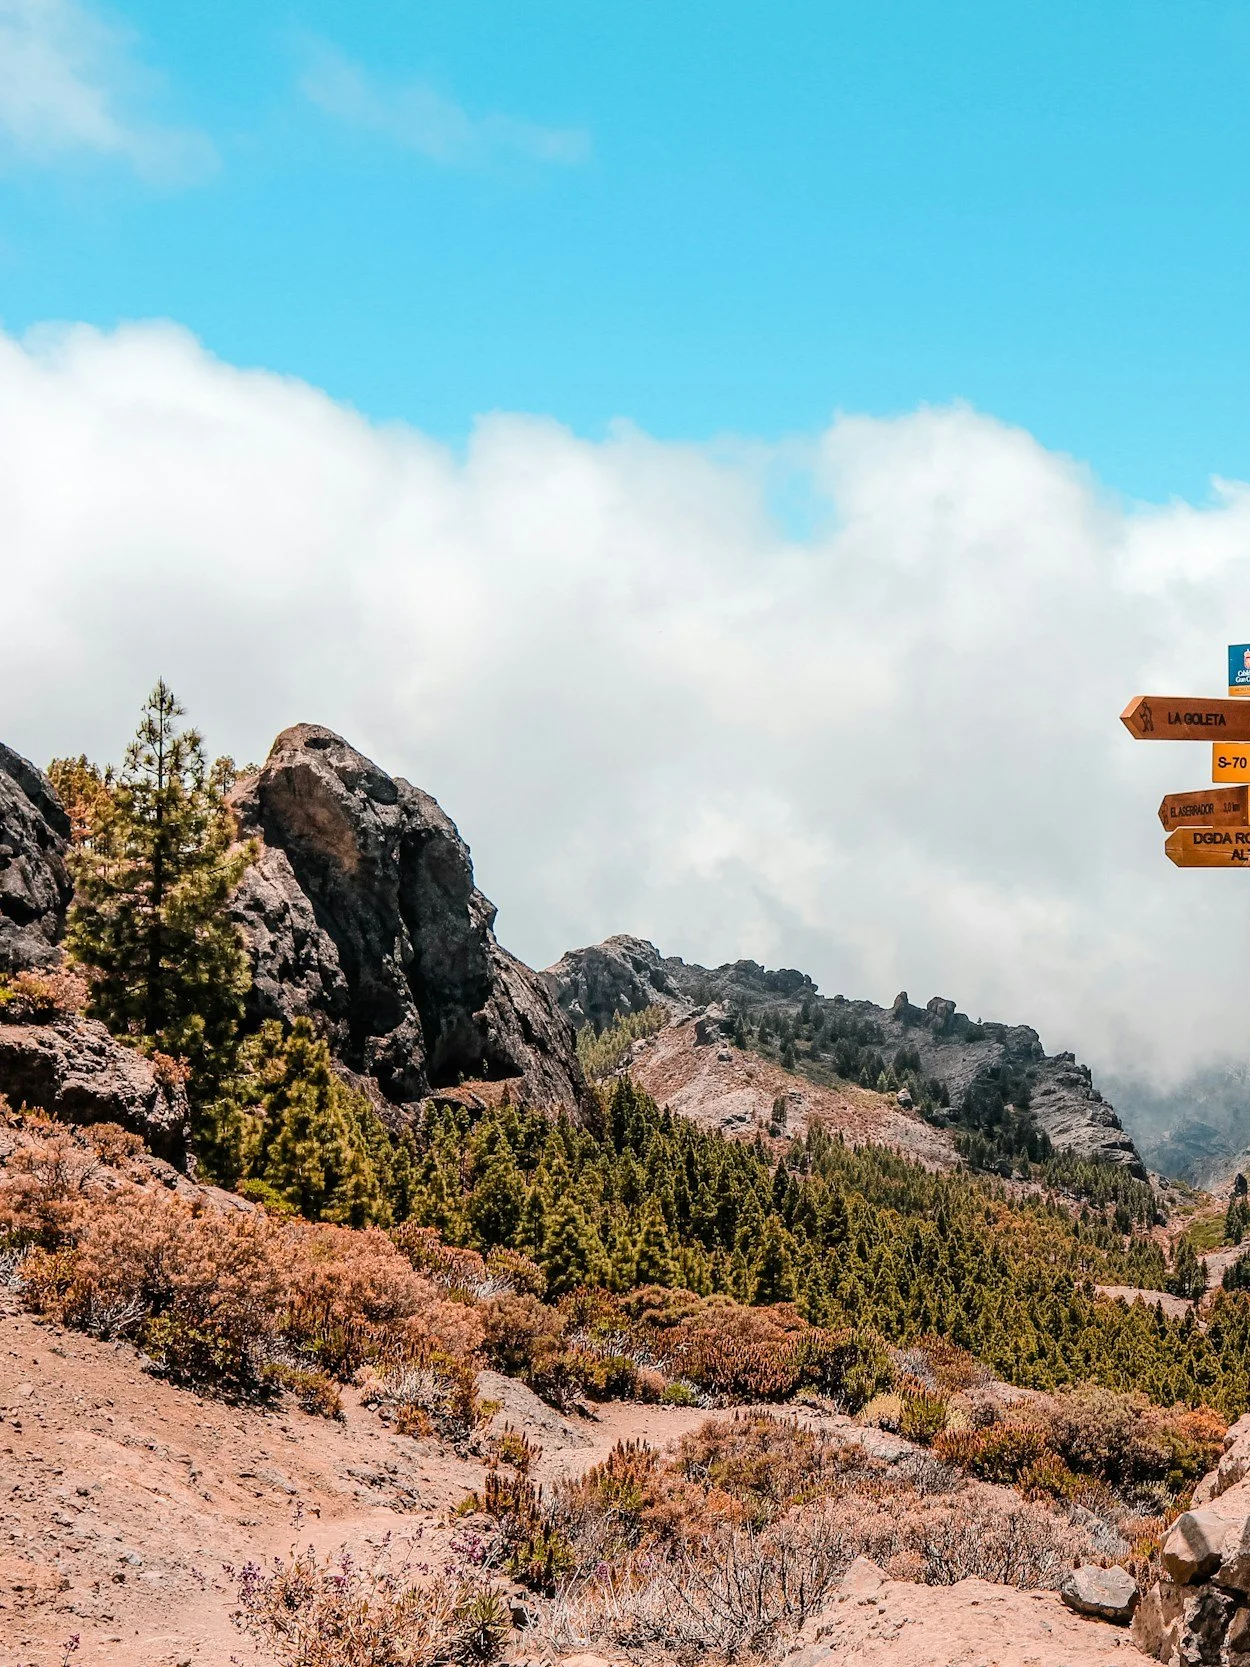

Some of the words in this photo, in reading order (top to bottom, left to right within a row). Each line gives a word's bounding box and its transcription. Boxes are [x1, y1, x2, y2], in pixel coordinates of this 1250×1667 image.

[1168, 712, 1181, 725] LA
[1184, 713, 1226, 726] GOLETA
[1218, 757, 1248, 769] S-70
[1170, 807, 1178, 818] EL
[1178, 803, 1215, 817] ASERRADOR
[1232, 802, 1240, 812] km
[1193, 832, 1232, 845] DGDA
